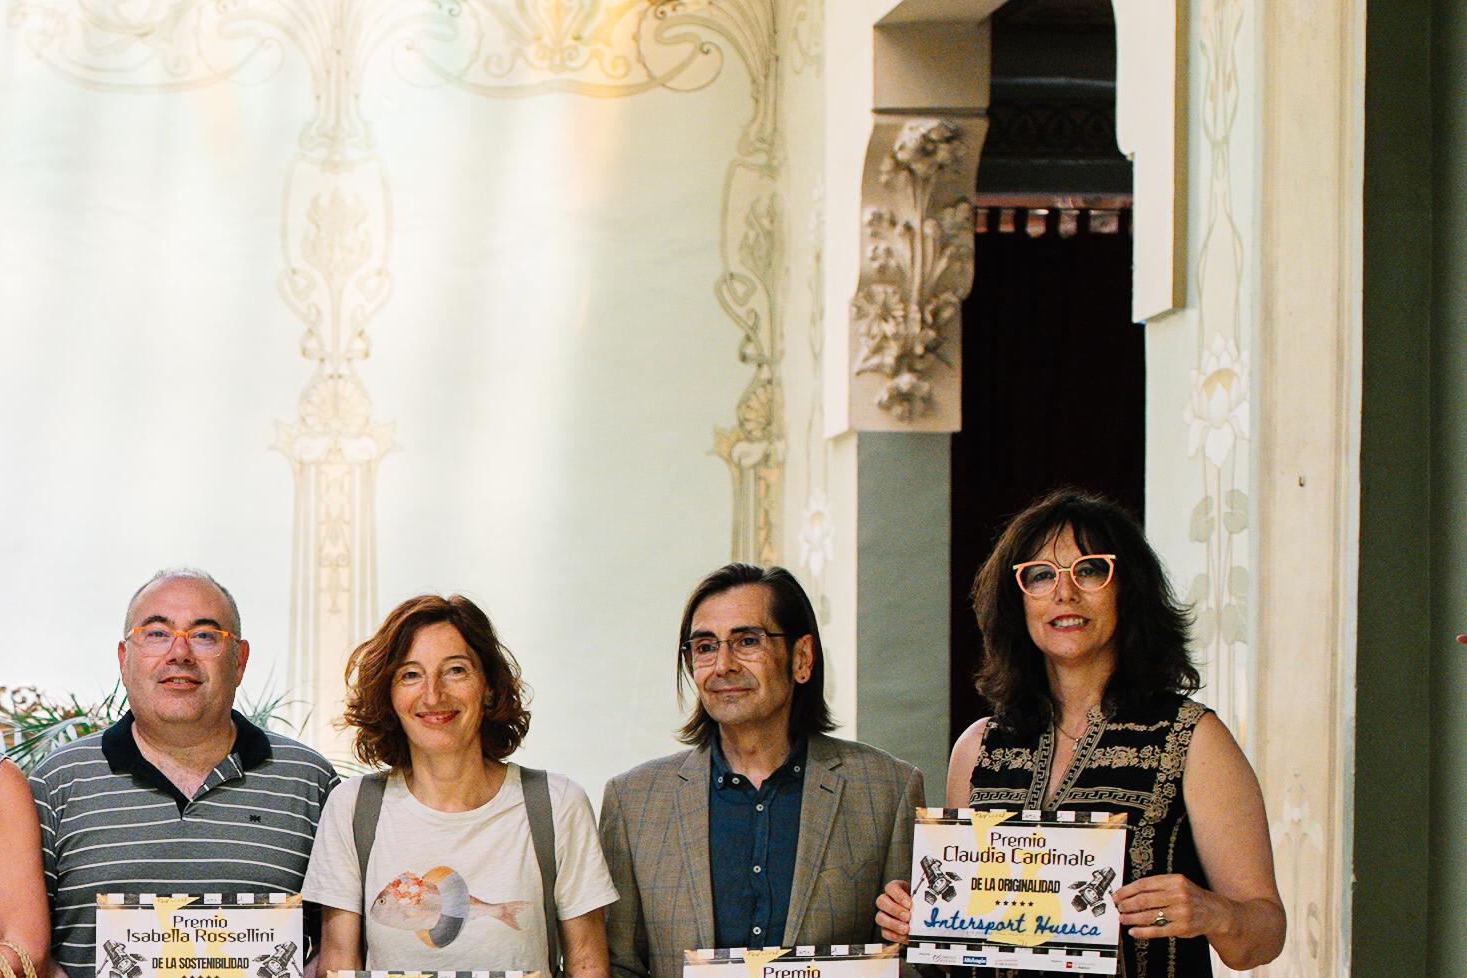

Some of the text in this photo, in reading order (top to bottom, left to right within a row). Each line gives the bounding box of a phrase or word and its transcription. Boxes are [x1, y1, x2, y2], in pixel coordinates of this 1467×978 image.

[990, 832, 1046, 848] Premio
[943, 846, 1095, 867] Claudia Cardinale
[971, 877, 1061, 893] DE LA ORIGINALIDAD
[173, 915, 228, 928] Premio
[923, 907, 1102, 937] Intersport Huesca
[127, 928, 274, 942] Isabella Rossellini
[152, 957, 249, 969] DE LA SOSTENIBILIDAD
